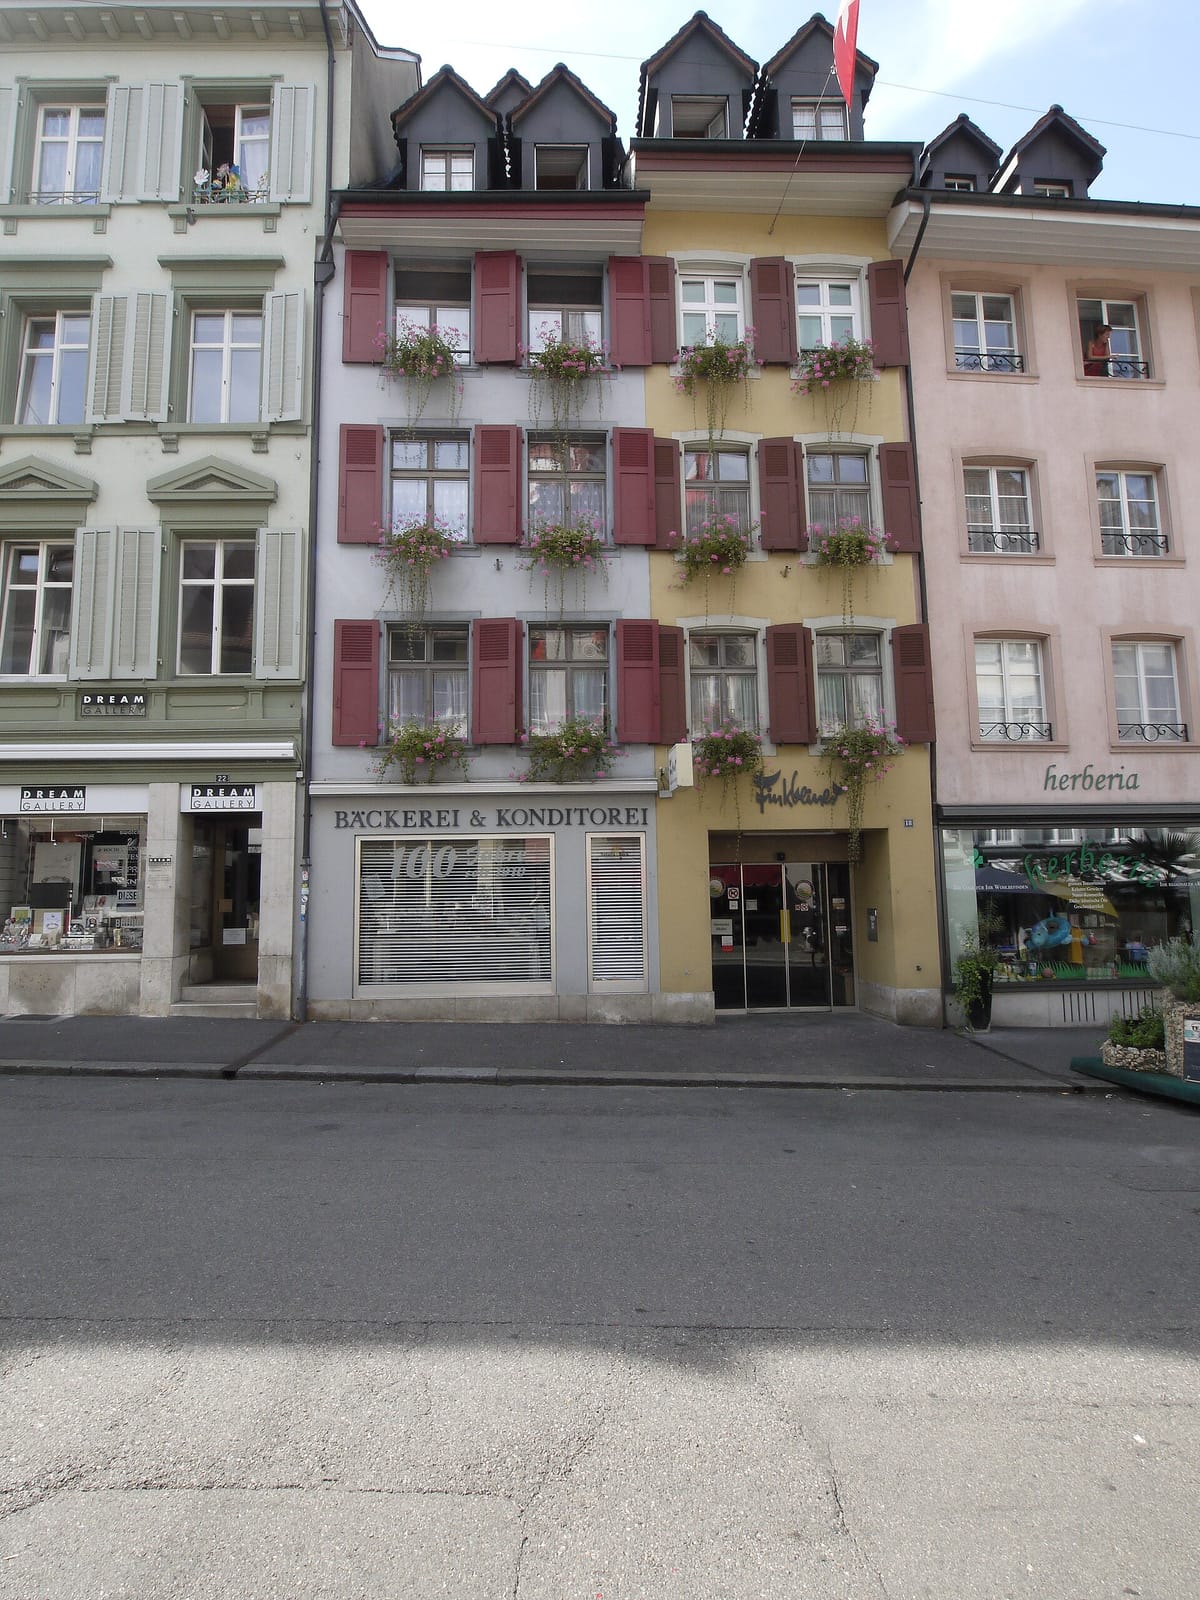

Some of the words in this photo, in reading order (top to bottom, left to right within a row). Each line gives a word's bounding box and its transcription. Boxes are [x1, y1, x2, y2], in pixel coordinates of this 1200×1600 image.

[83, 695, 144, 704] DREAM
[83, 706, 145, 715] GALLERY
[1043, 764, 1140, 791] herberia
[23, 790, 83, 798] DREAM
[194, 788, 253, 797] DREAM
[23, 802, 83, 811] GALLERY
[193, 800, 253, 808] GALLERY
[334, 809, 460, 829] BÄCKEREI
[469, 809, 487, 828] &
[496, 807, 649, 827] KONDITOREI
[390, 846, 457, 879] 100
[1023, 840, 1161, 891] herberia
